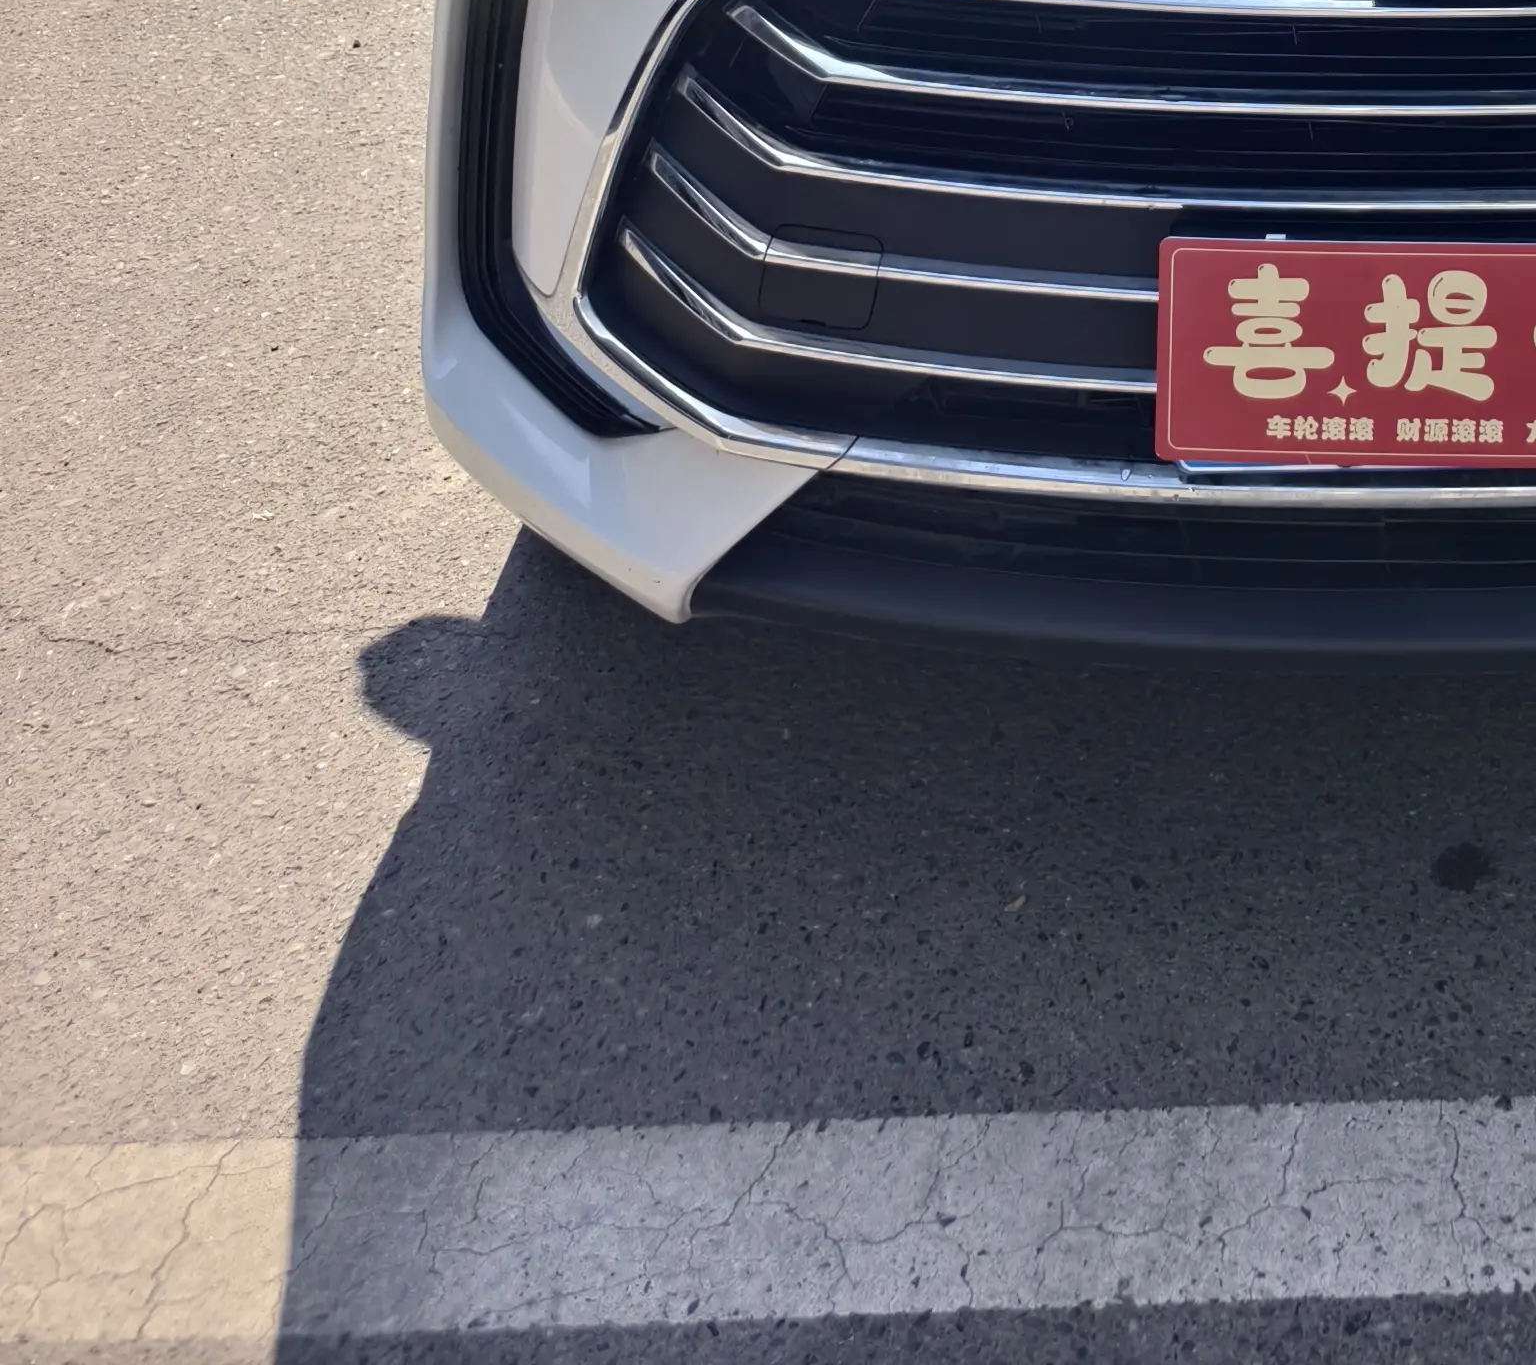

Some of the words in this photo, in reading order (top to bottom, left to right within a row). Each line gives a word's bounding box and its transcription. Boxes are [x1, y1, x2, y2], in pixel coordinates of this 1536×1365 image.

[1266, 415, 1374, 441] 车轮滚滚
[1396, 417, 1504, 443] 财源滚滚
